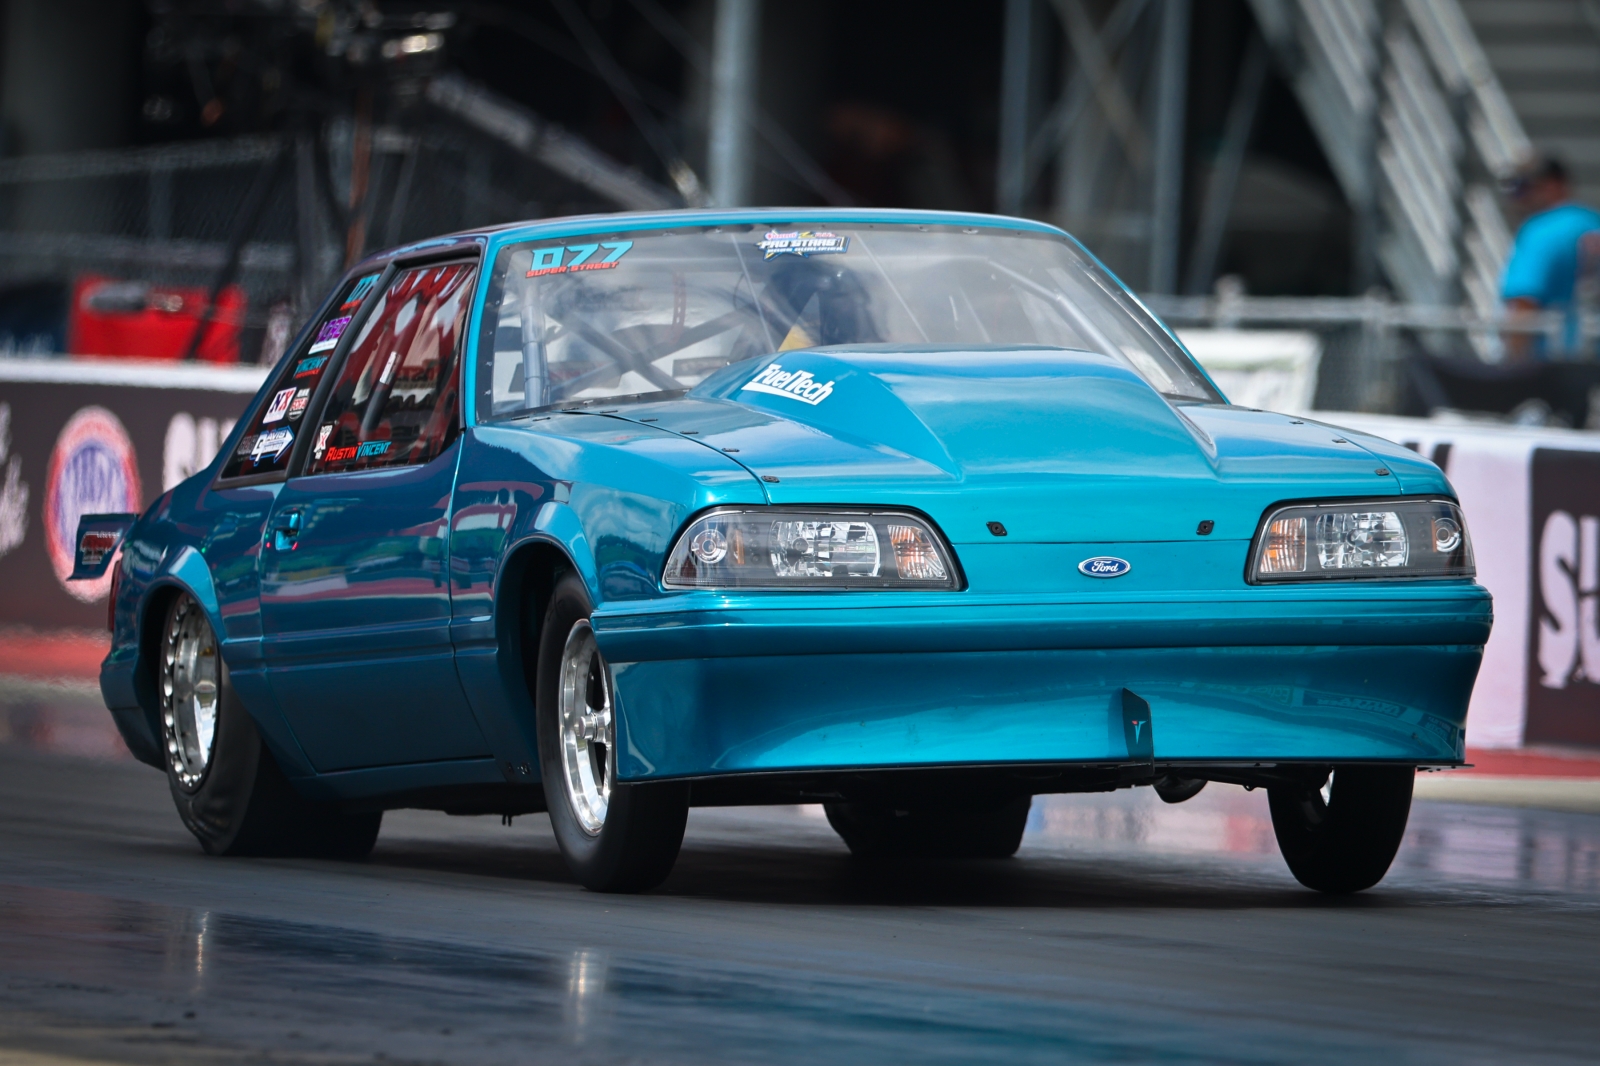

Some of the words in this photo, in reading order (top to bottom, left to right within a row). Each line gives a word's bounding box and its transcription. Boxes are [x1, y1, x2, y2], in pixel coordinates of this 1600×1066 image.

[531, 241, 634, 270] 077
[526, 266, 568, 278] SUPER
[570, 262, 619, 272] STREET
[752, 363, 835, 401] FuelTech
[269, 389, 296, 413] NX
[356, 441, 392, 461] VINCENT
[1091, 560, 1119, 572] Ford
